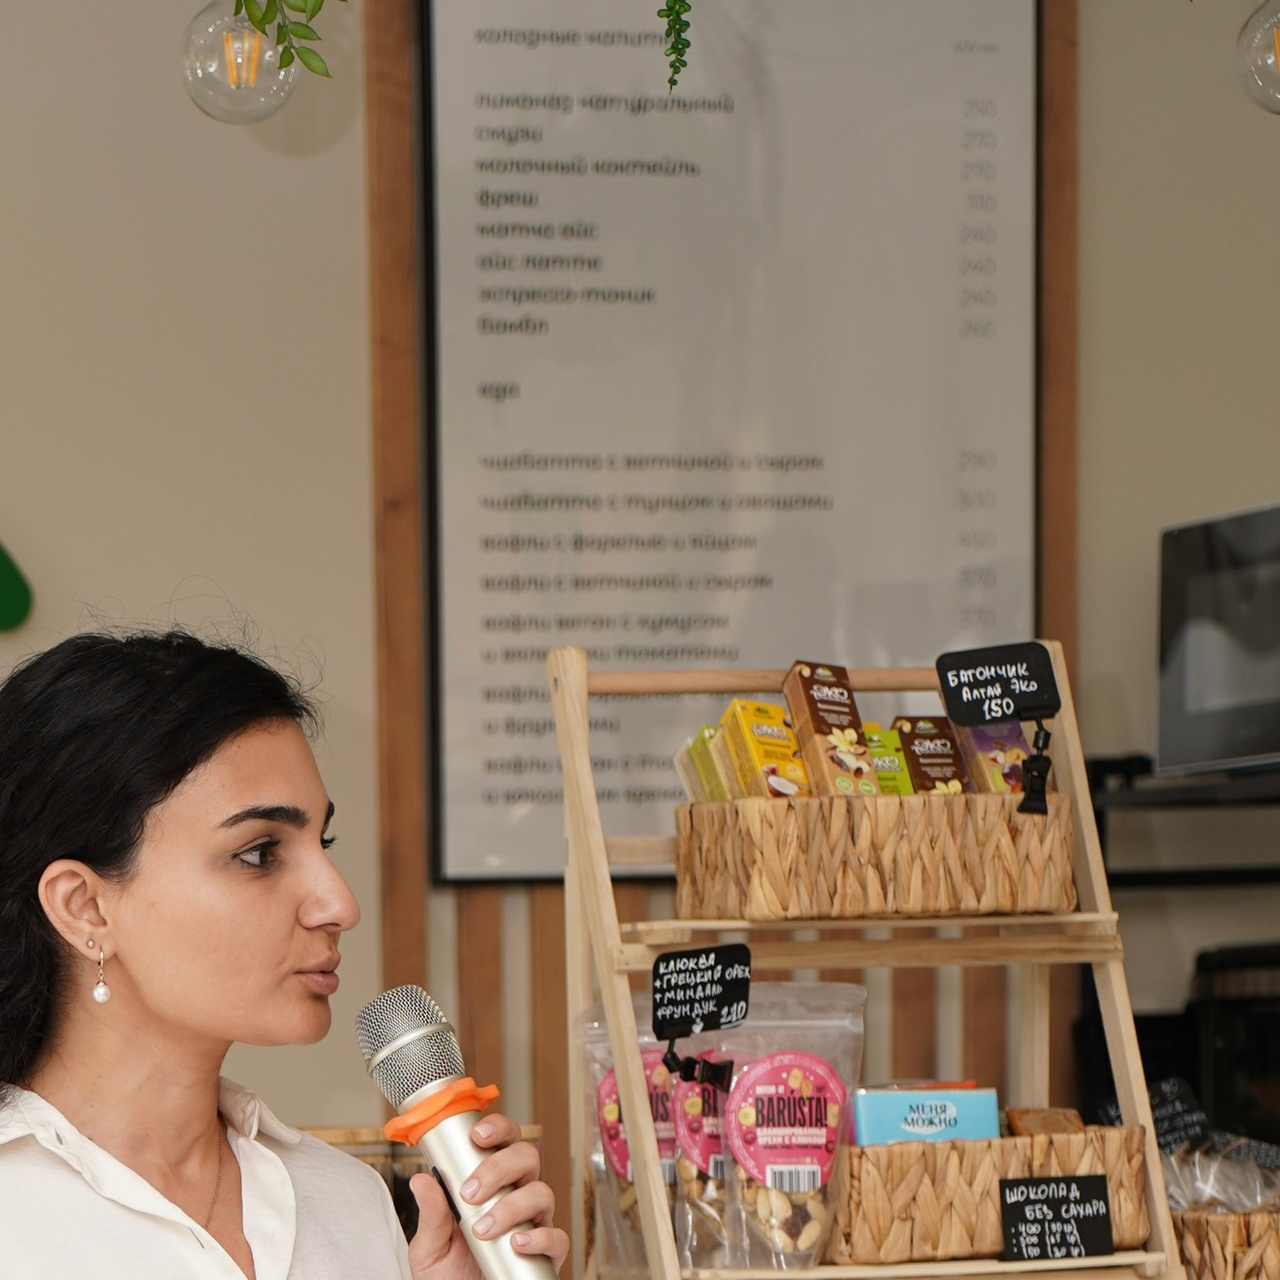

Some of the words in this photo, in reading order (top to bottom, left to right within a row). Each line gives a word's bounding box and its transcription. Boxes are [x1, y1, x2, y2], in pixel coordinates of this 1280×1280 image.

[584, 31, 666, 48] напит
[947, 662, 1029, 687] БАТОНЧИК
[983, 697, 1014, 720] 150
[659, 952, 716, 975] КЛЮКВА
[725, 963, 751, 981] ОРЕХ
[904, 1117, 958, 1128] МОЖНО
[1006, 1182, 1080, 1204] ШОКОЛАД
[1025, 1203, 1053, 1220] БЕЗ
[1061, 1199, 1107, 1219] САХАРА
